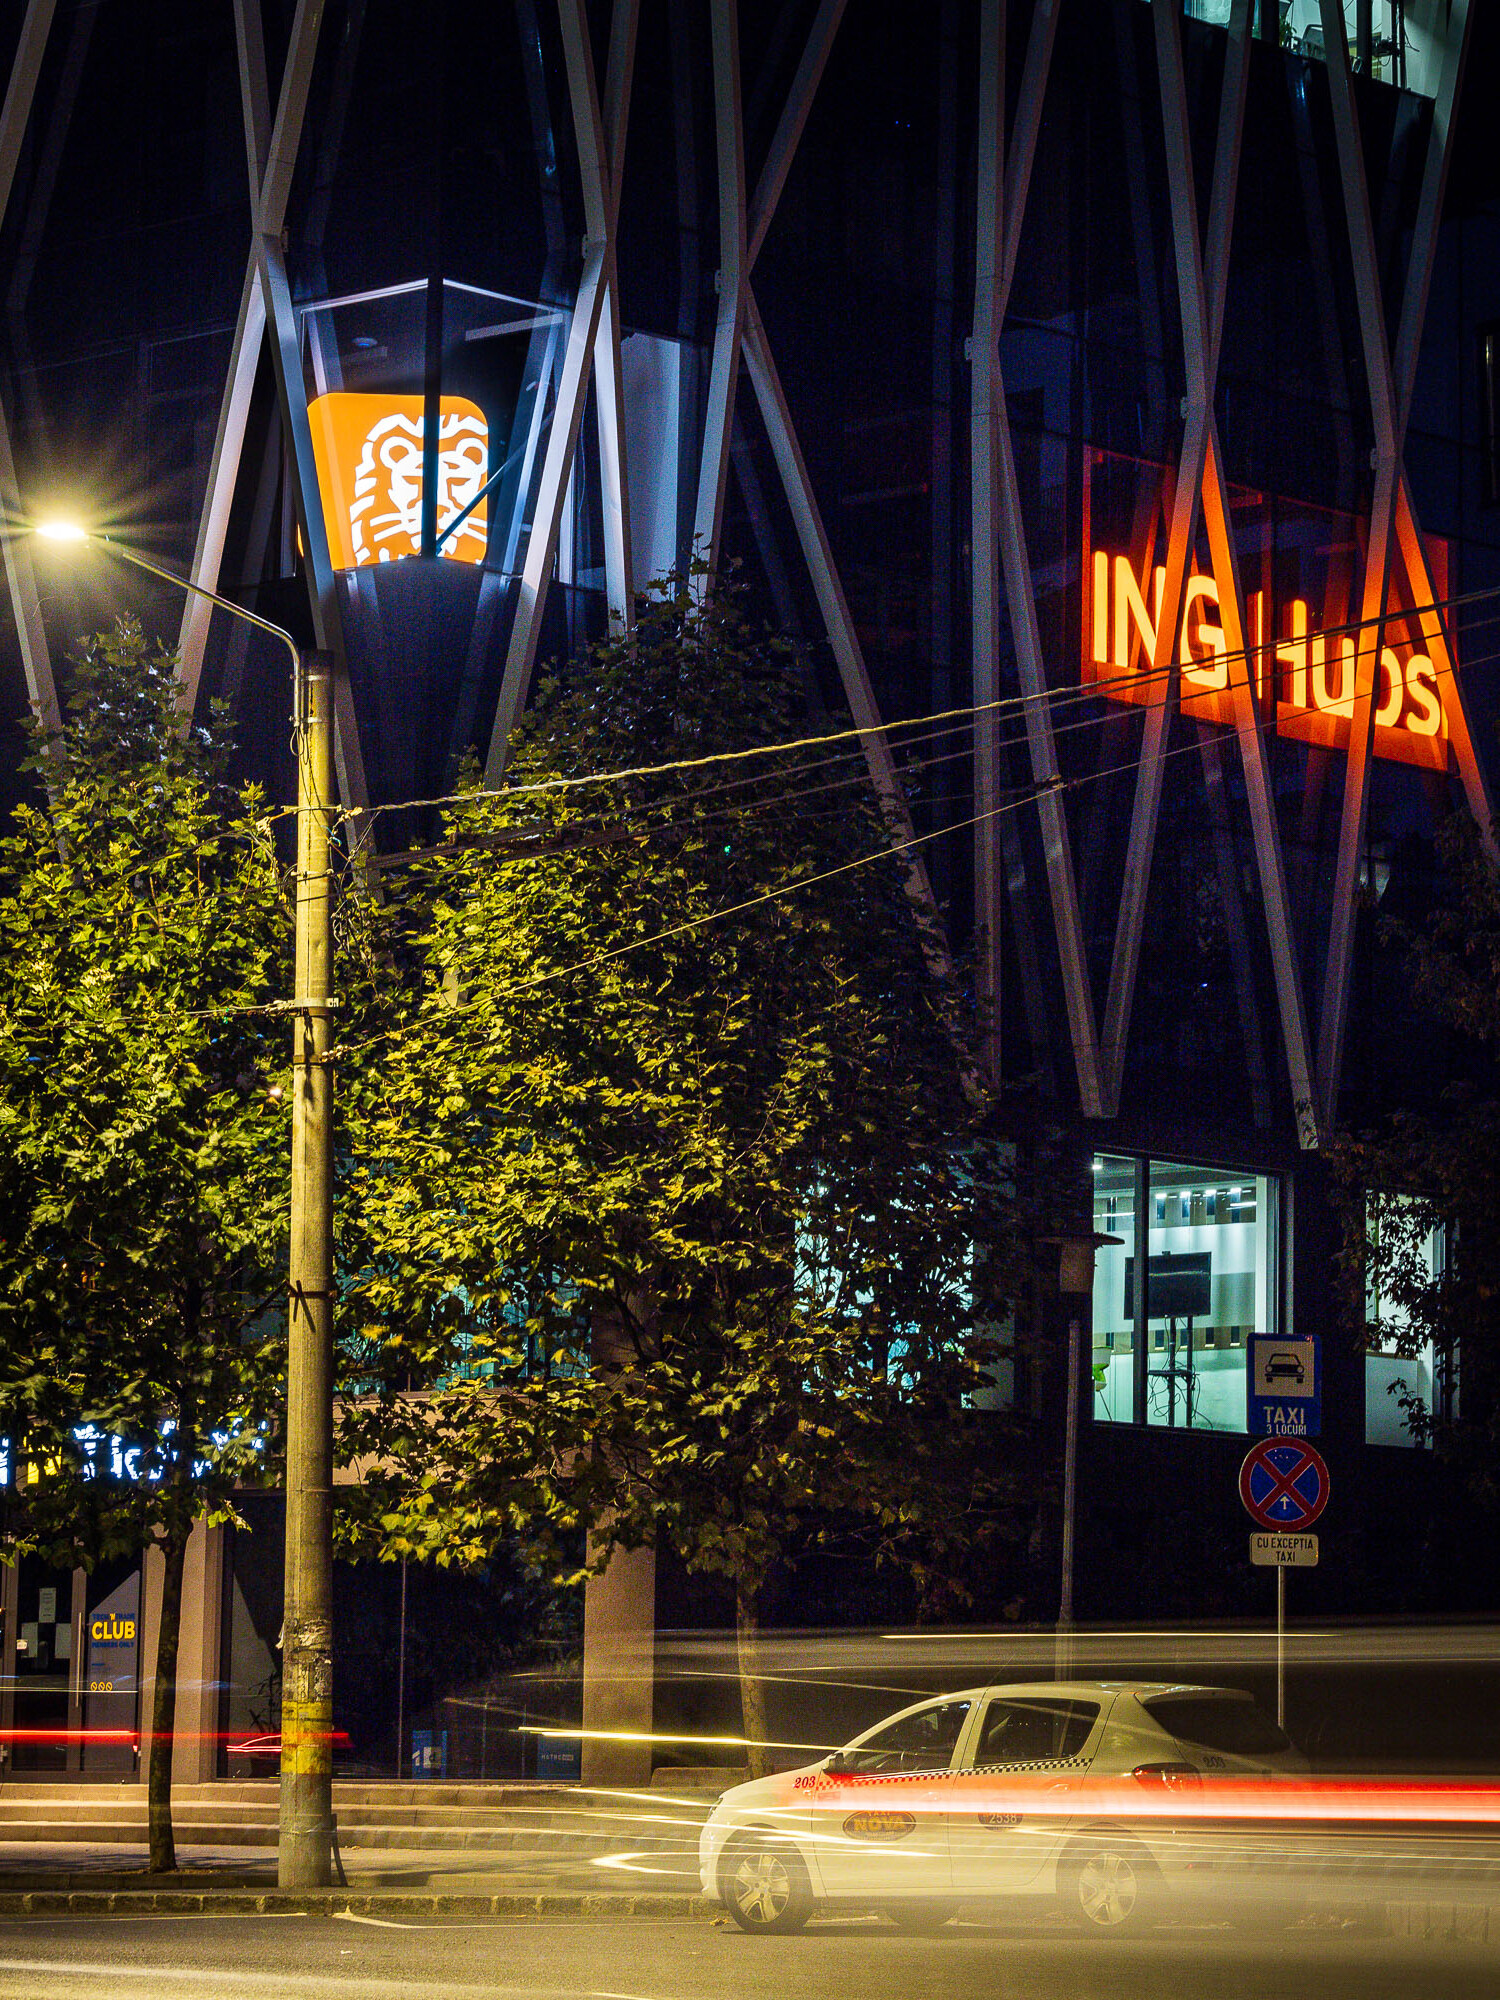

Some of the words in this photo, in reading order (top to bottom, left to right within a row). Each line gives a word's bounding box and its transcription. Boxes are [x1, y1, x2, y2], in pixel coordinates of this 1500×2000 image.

[1094, 550, 1227, 689] ING
[1263, 1406, 1304, 1425] TAXI
[1266, 1424, 1272, 1434] 3
[1276, 1424, 1307, 1435] LOCURI
[1257, 1537, 1269, 1548] CU
[1276, 1550, 1296, 1562] TAXI
[91, 1621, 136, 1640] CLUB
[795, 1776, 816, 1789] 203
[853, 1816, 907, 1832] NOVA
[989, 1813, 1017, 1824] 2538
